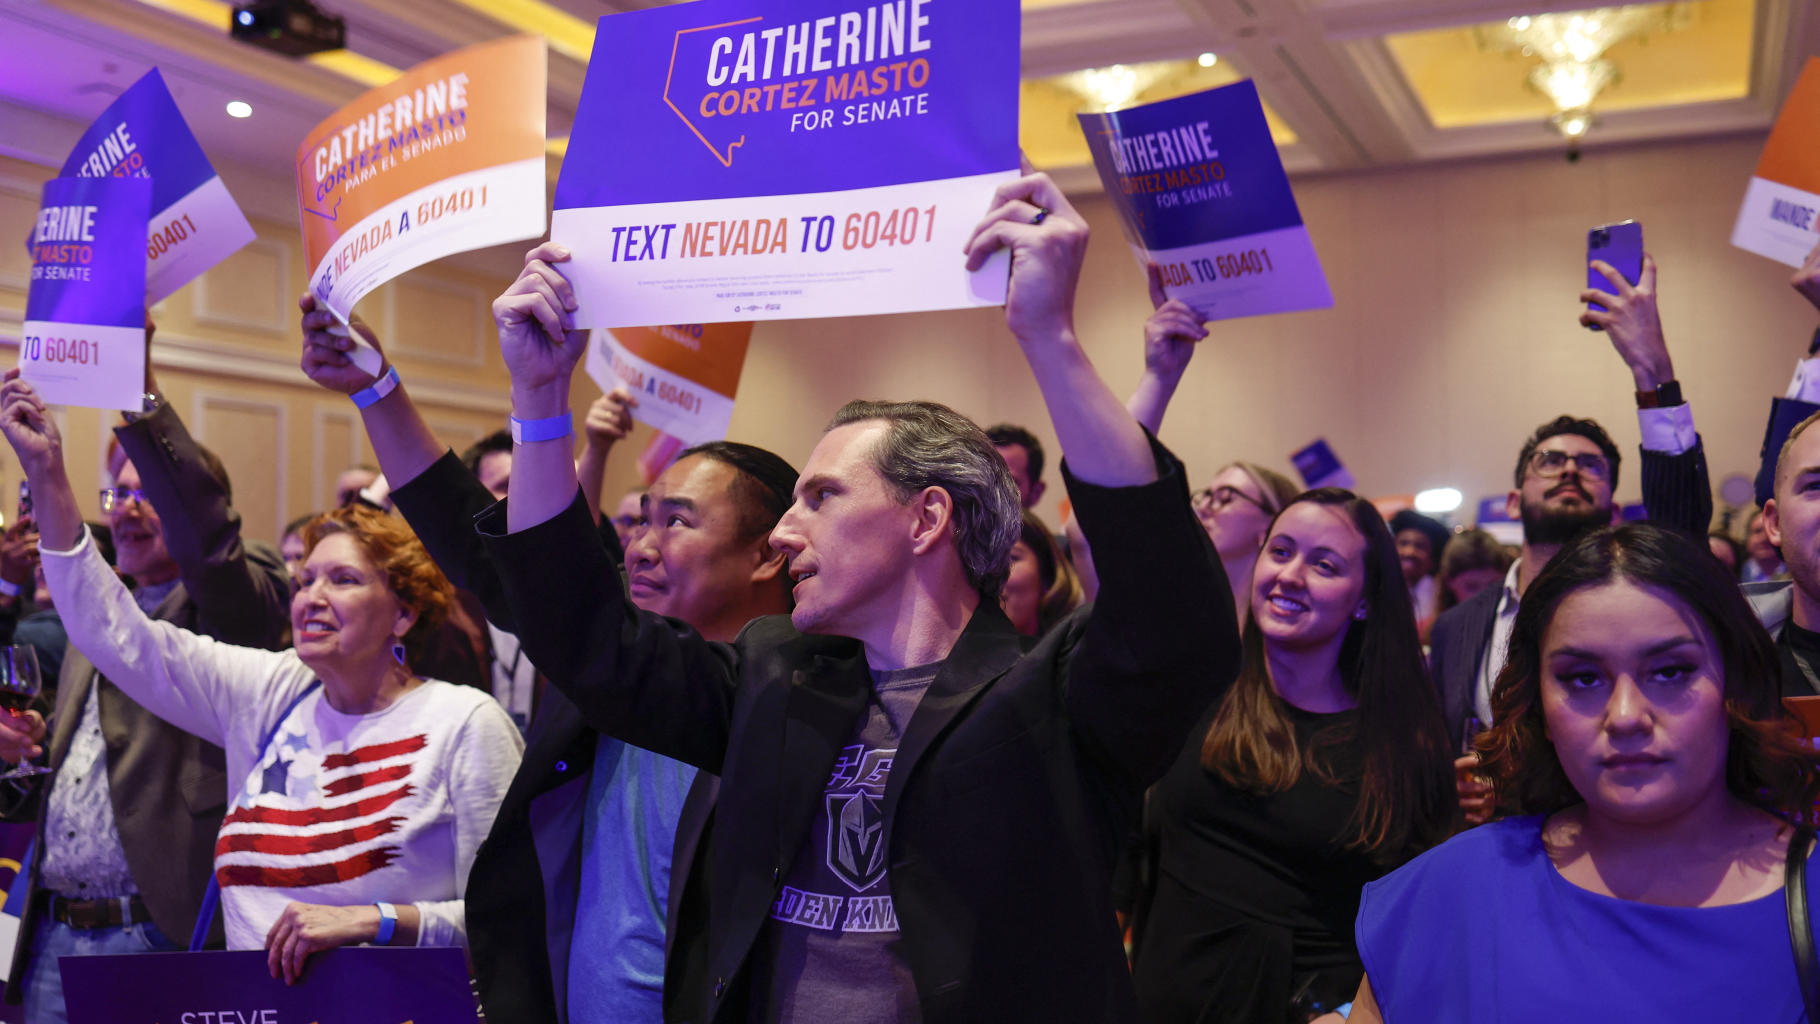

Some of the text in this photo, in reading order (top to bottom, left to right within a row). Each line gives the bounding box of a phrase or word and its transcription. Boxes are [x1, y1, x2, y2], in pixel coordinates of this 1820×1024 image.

[706, 0, 931, 87] CATHERINE
[699, 58, 930, 118] CORTEZ MASTO
[790, 93, 929, 132] FOR SENATE
[315, 72, 469, 183] CATHERINE
[1109, 121, 1219, 174] CATHERINE
[316, 108, 466, 202] CORTEZ MASTO
[345, 126, 467, 192] PARA EL SENADO
[1165, 161, 1225, 190] MASTO
[1156, 181, 1232, 208] FOR SENATE
[147, 214, 197, 260] 60401
[335, 219, 392, 281] NEVADA
[398, 210, 410, 235] A
[417, 184, 488, 226] 60401
[611, 204, 936, 262] TEXT NEVADA TO 60401
[45, 266, 92, 281] SENATE
[1191, 258, 1217, 283] TO
[1215, 248, 1273, 279] 60401
[24, 336, 98, 365] TO 60401
